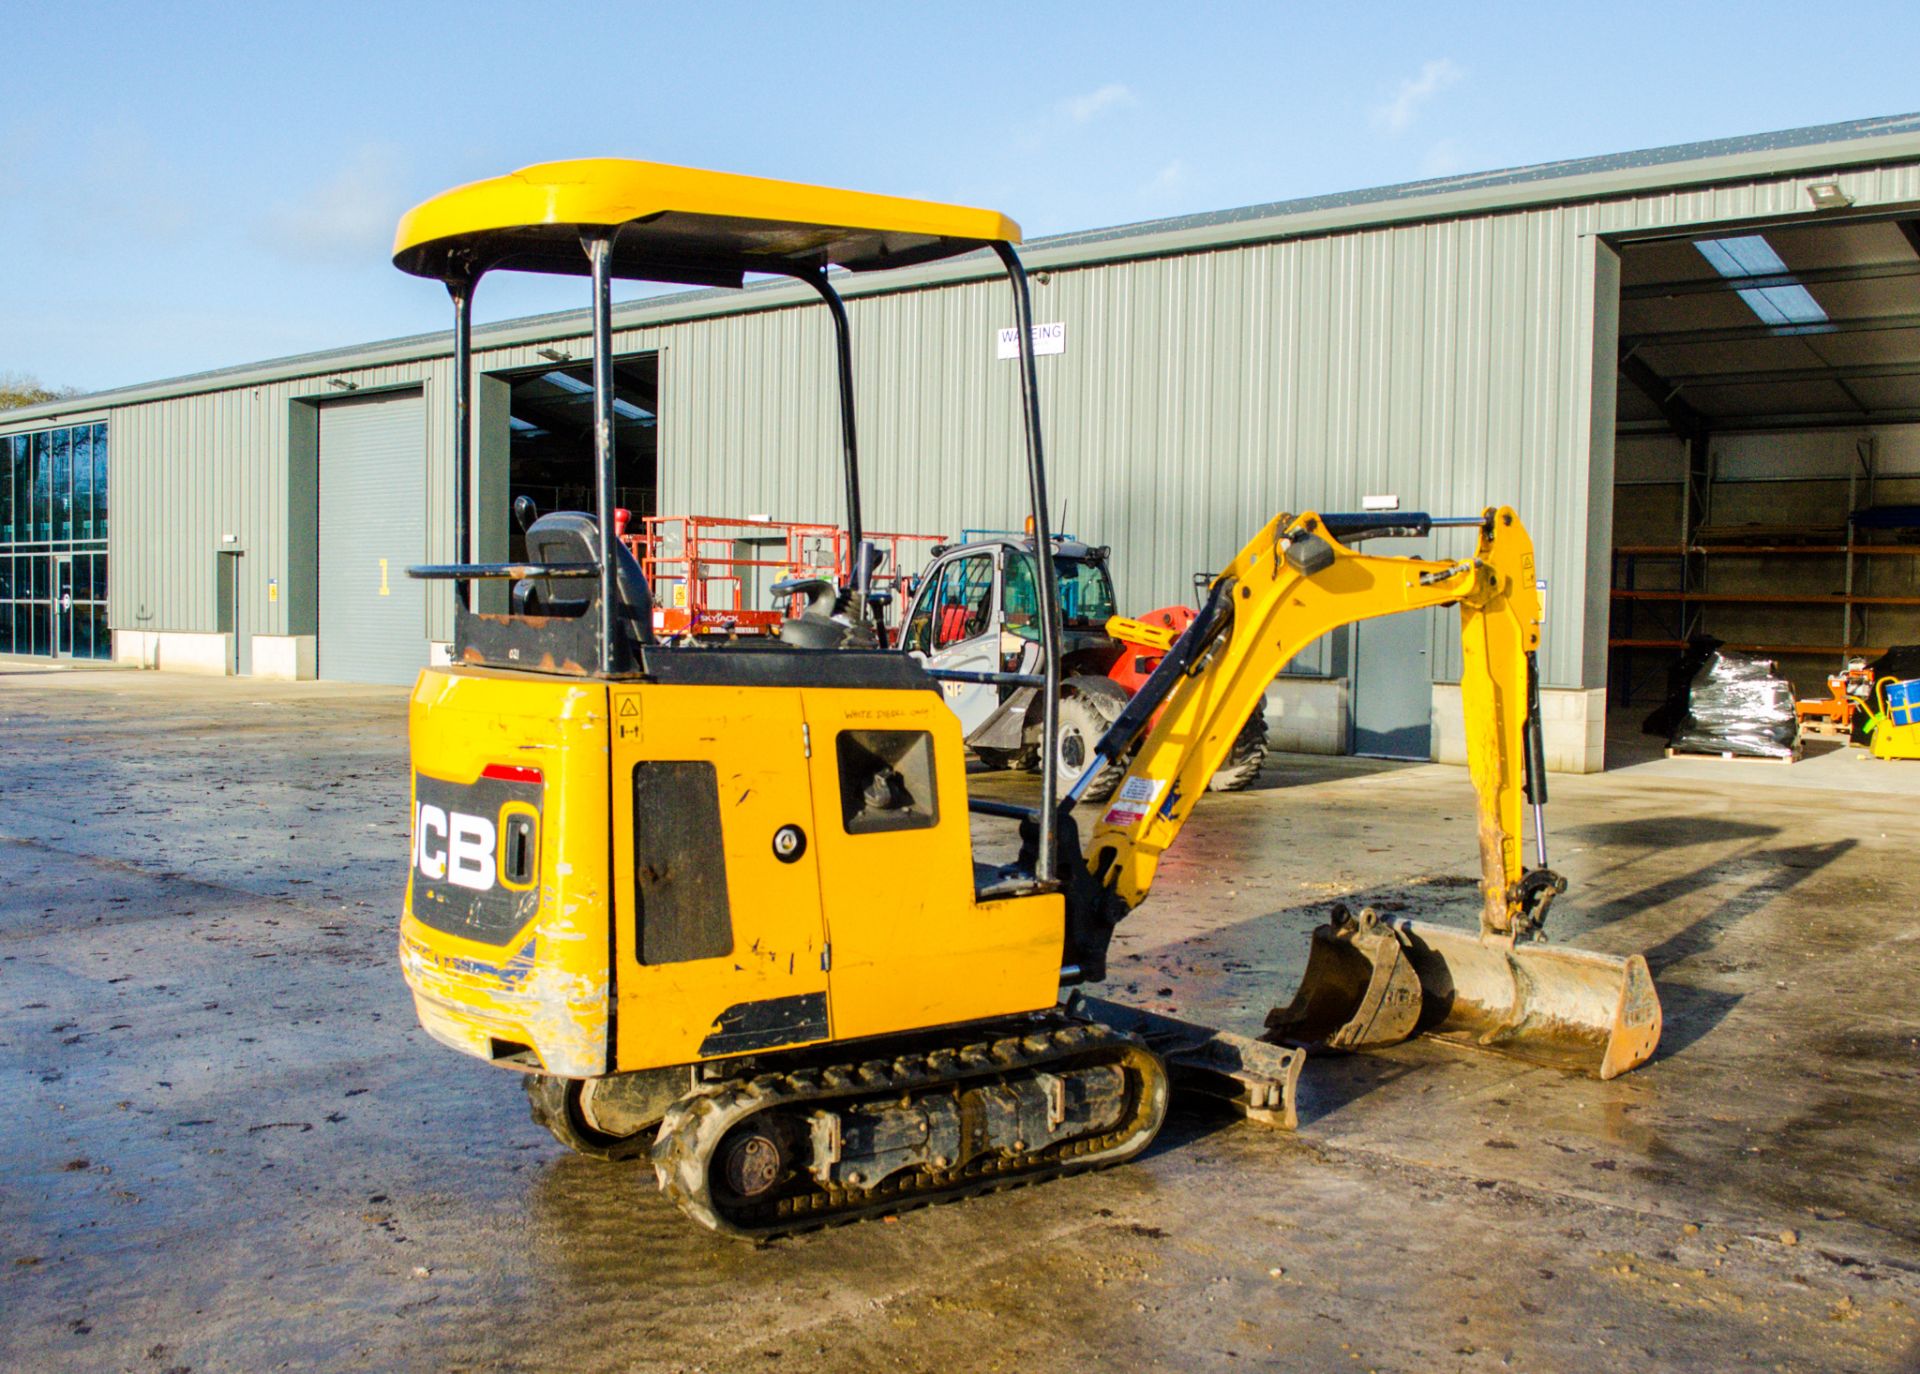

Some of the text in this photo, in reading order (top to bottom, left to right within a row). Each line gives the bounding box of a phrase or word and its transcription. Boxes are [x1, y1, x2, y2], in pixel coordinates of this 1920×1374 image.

[1002, 325, 1062, 343] WAEING
[379, 559, 390, 596] 1
[844, 708, 873, 719] WHITE
